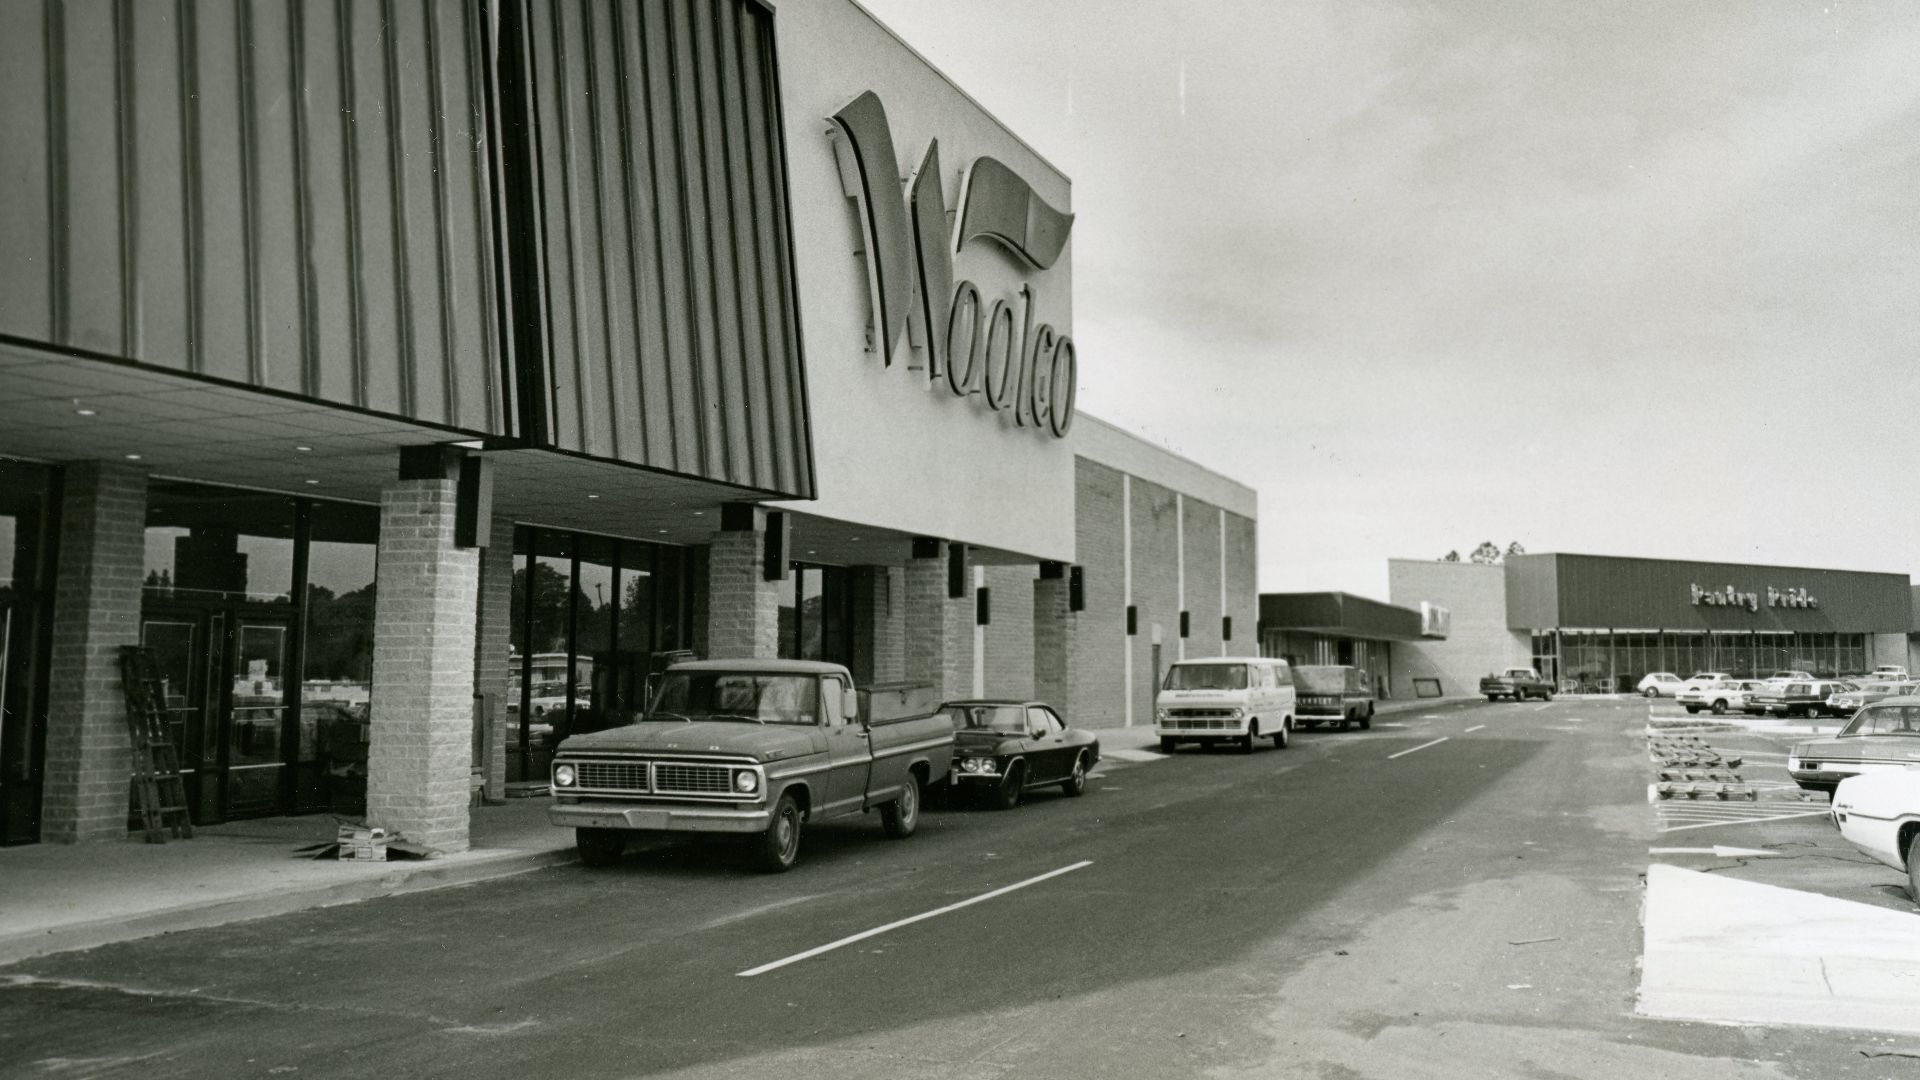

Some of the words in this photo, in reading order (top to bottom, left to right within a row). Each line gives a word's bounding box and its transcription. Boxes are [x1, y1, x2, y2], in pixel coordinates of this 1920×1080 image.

[825, 89, 1076, 439] Woolco
[1690, 583, 1758, 612] Pantry
[1767, 586, 1818, 608] Pride
